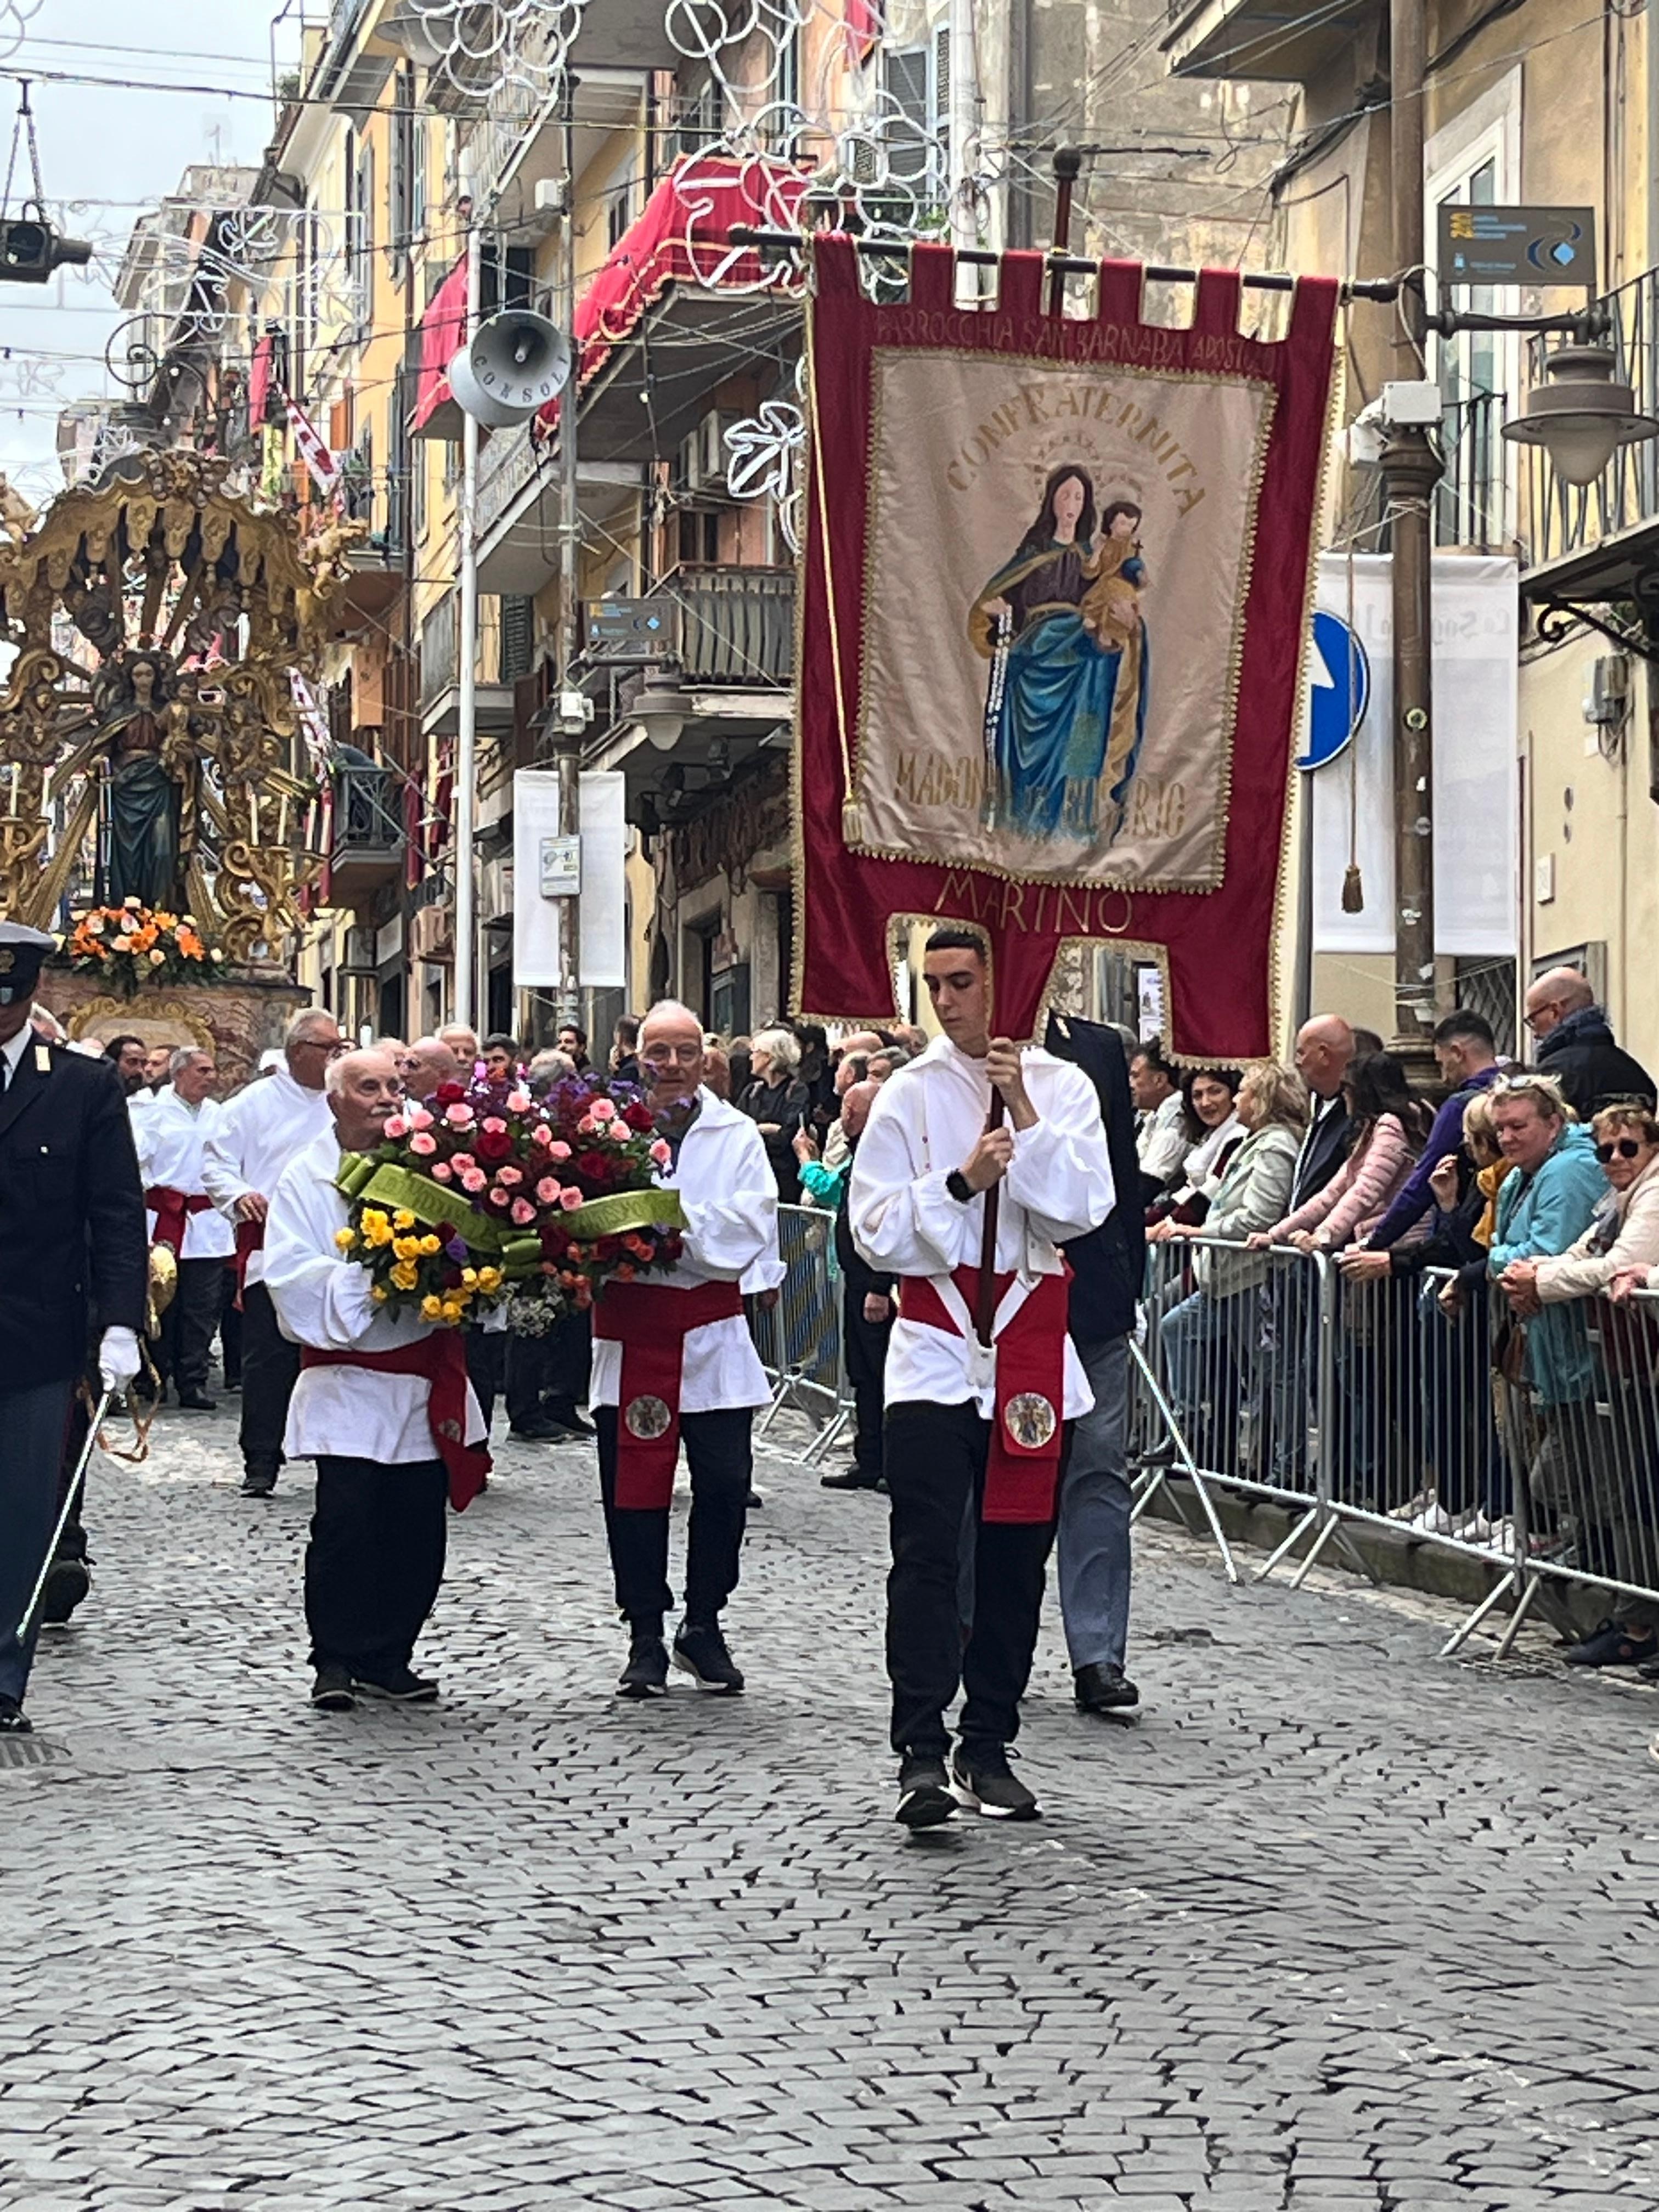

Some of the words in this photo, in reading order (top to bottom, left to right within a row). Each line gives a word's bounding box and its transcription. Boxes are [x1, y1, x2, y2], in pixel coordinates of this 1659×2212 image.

[878, 309, 1014, 348] PARROCCHIA
[1022, 318, 1068, 357] SAN
[1076, 323, 1184, 367] BARNABA
[474, 356, 568, 403] CONSOLI
[946, 382, 1206, 518] CONFRATERNITA
[934, 871, 1133, 934] MARINO
